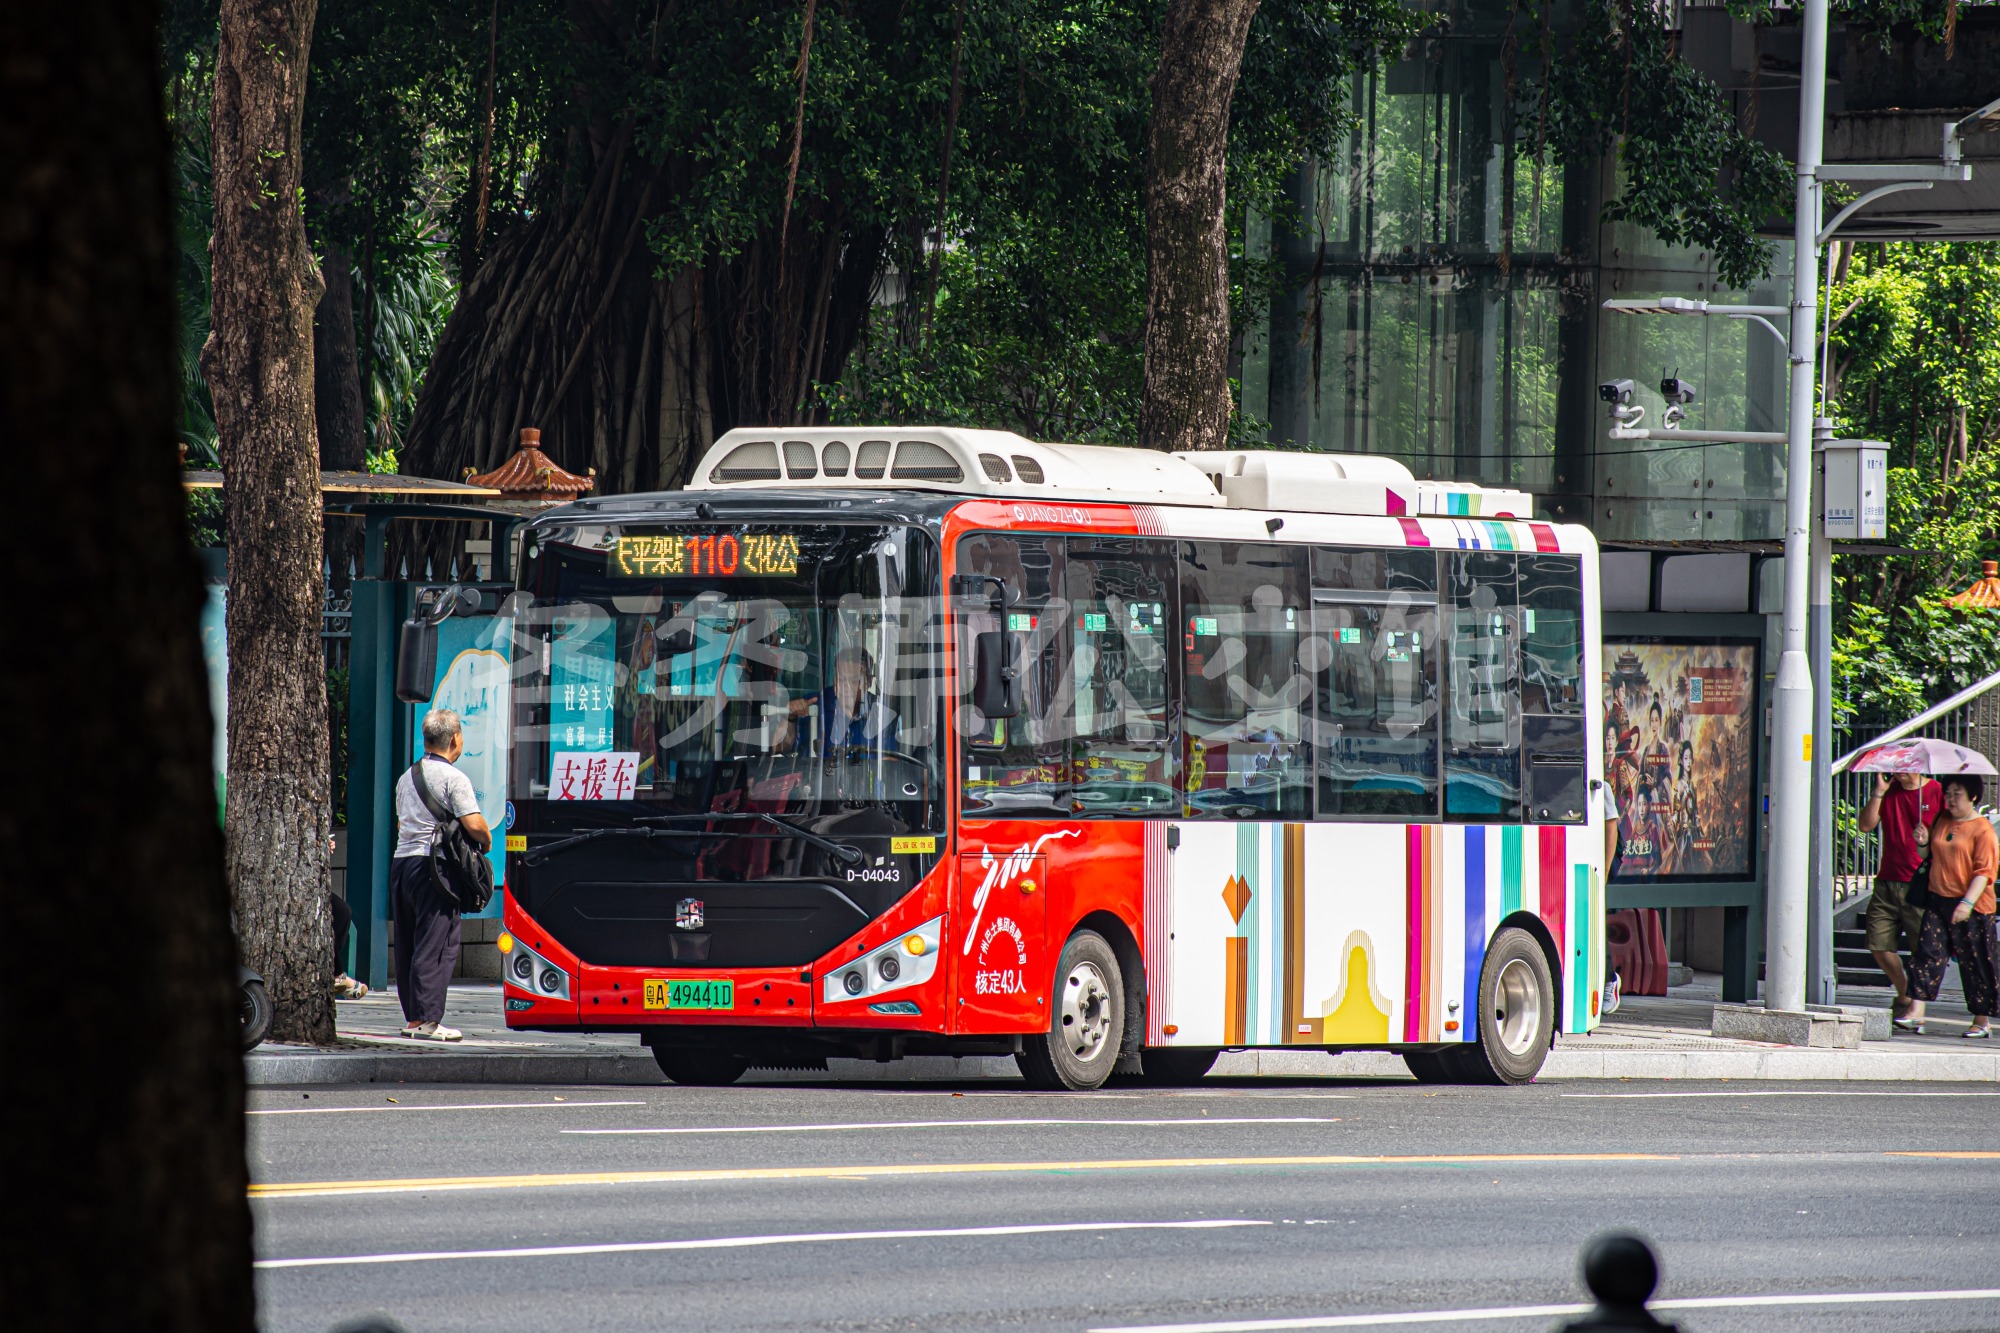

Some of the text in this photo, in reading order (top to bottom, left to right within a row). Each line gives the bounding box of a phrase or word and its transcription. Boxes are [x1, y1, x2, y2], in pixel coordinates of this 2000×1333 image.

[1013, 505, 1092, 524] GUANGZHOU
[686, 535, 739, 575] 110
[564, 684, 614, 712] 社会主义
[556, 756, 634, 801] 支援车
[903, 841, 934, 850] 盲区勿近
[847, 869, 900, 882] D-04043
[978, 916, 1027, 967] 广州巴士集团有限公司
[975, 969, 1027, 995] 核定43人
